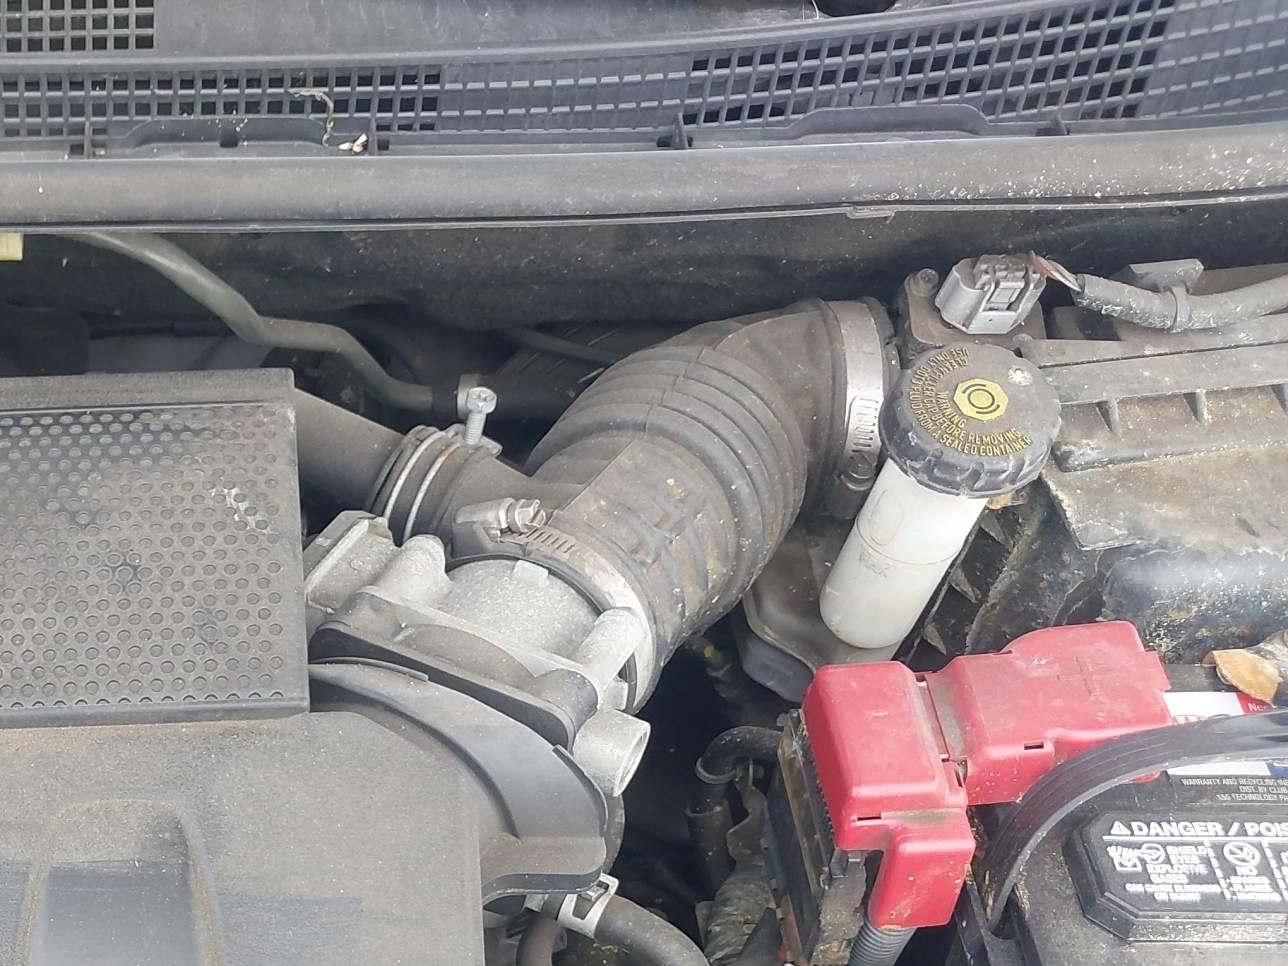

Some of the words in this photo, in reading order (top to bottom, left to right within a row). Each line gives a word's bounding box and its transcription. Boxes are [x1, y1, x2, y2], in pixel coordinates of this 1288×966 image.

[927, 351, 950, 369] ONLY
[951, 347, 969, 358] USE
[910, 387, 922, 409] FLUID
[936, 391, 967, 428] WARNING
[914, 410, 933, 433] FROM
[923, 398, 939, 413] CAP
[931, 414, 967, 441] BEFORE
[968, 427, 1021, 445] REMOVING
[940, 433, 978, 456] SEALED
[980, 435, 1032, 457] CONTAINER
[1181, 778, 1221, 786] WARRANTY
[1130, 821, 1225, 836] DANGER
